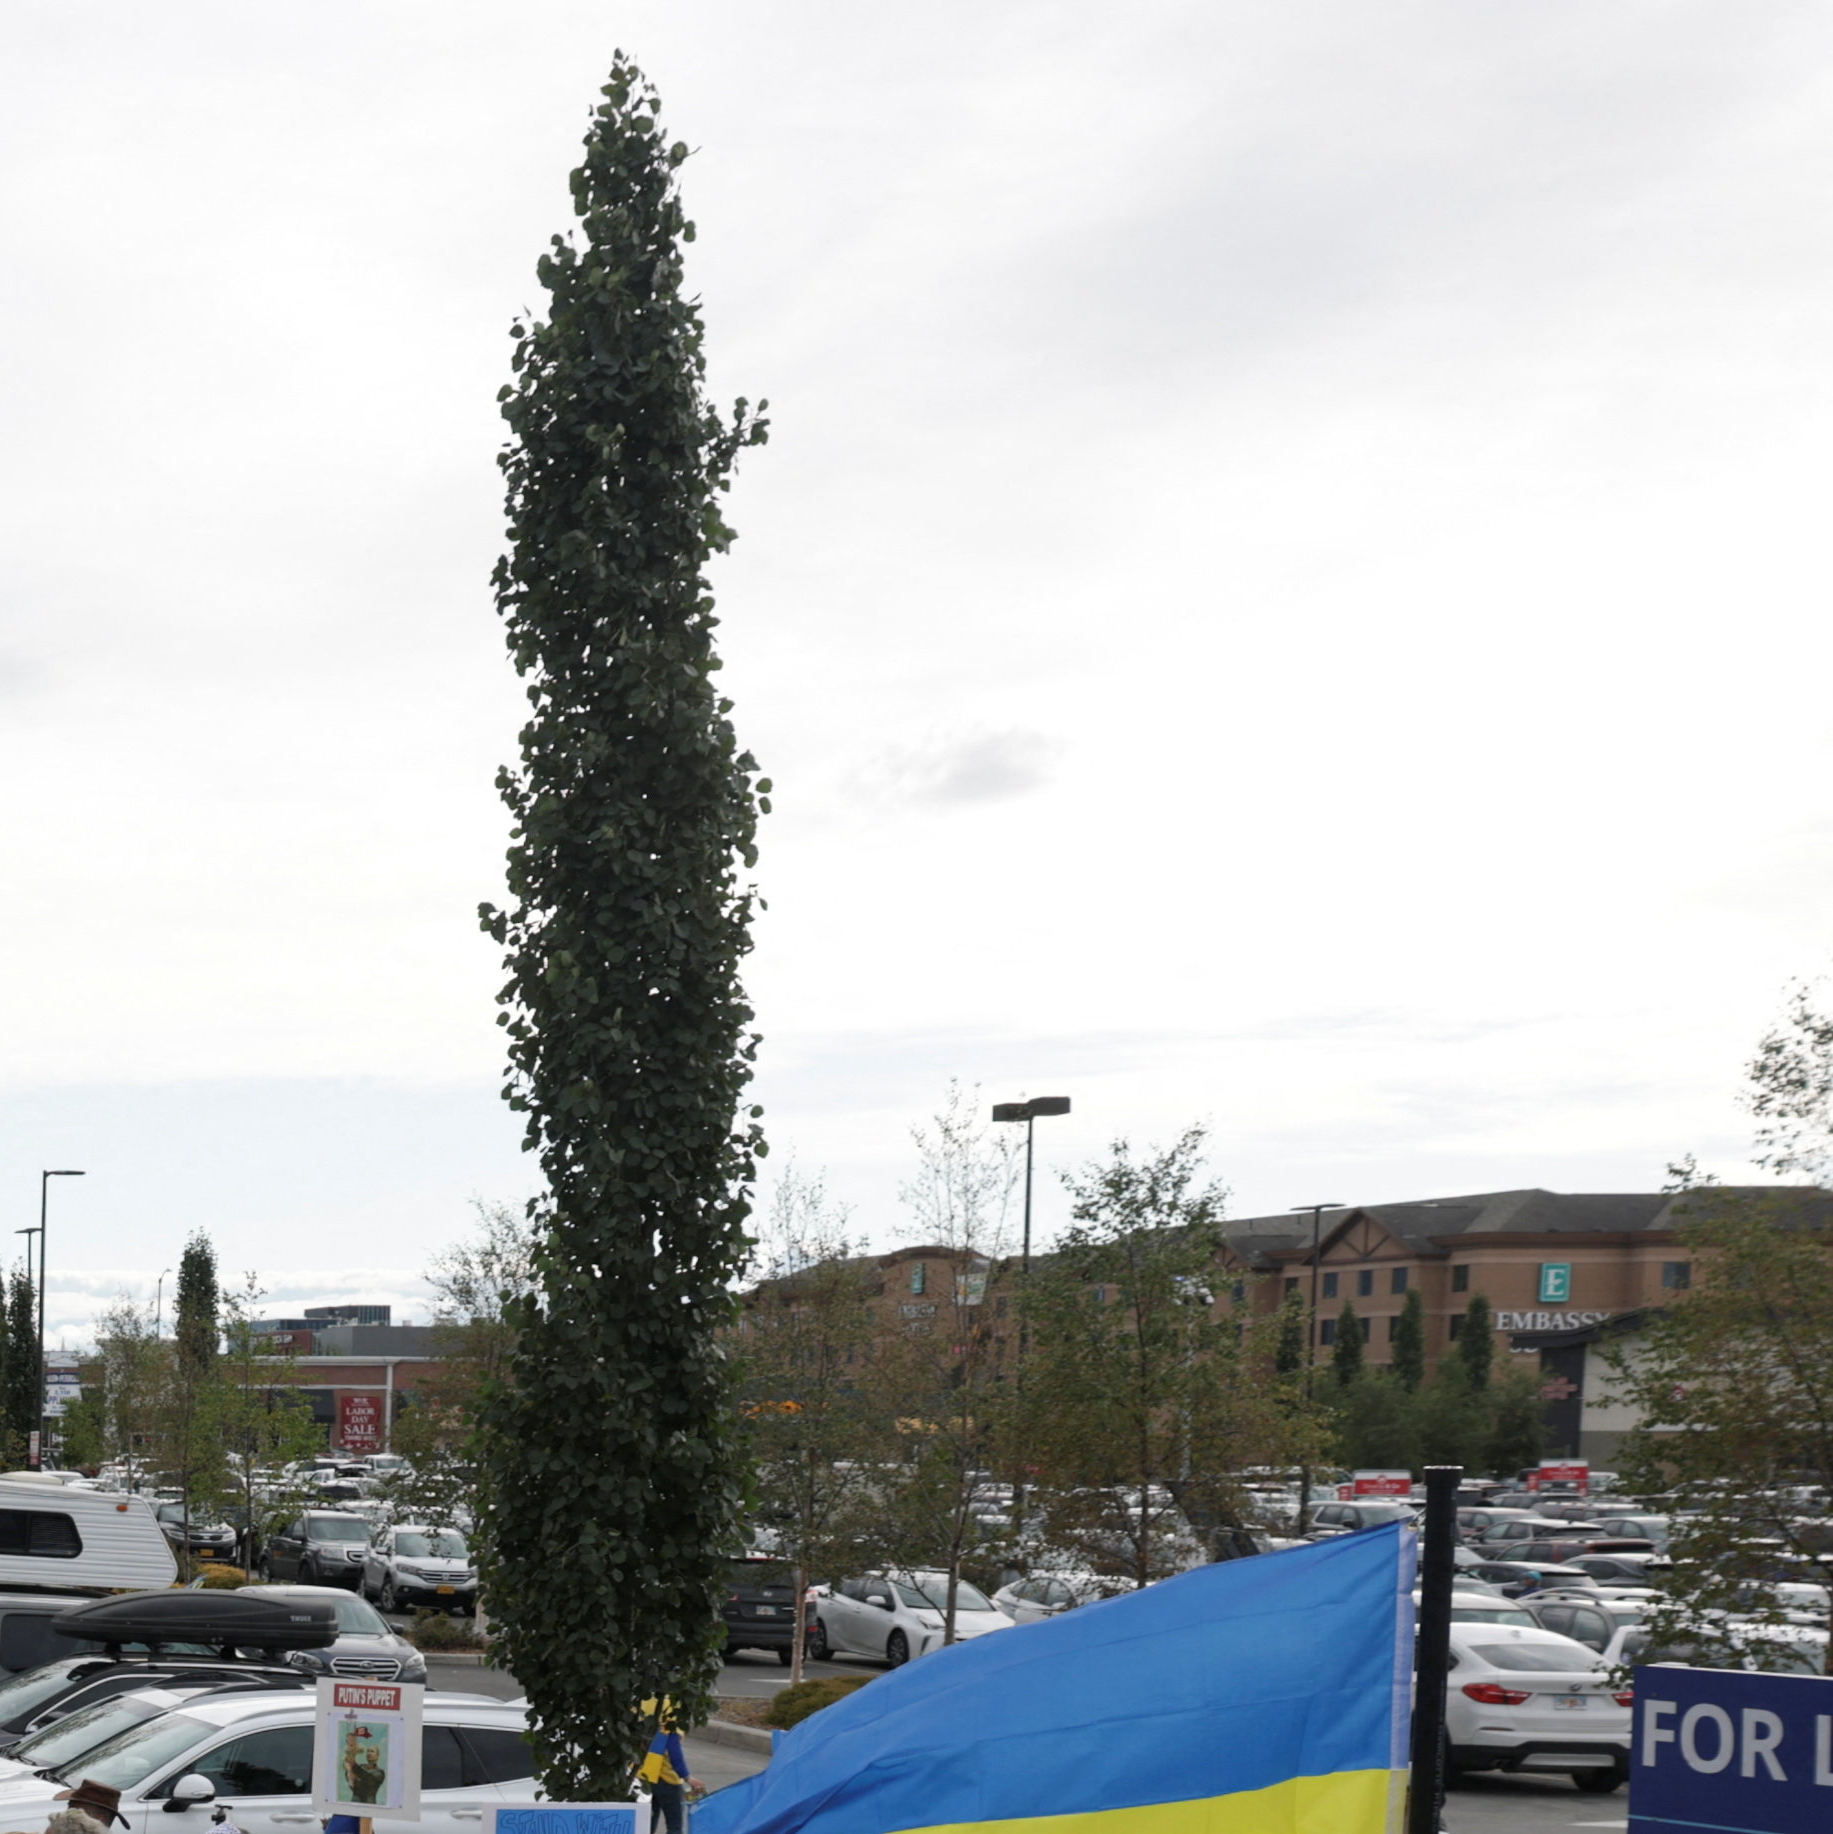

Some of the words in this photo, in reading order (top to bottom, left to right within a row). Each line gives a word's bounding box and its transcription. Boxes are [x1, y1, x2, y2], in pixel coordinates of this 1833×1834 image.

[346, 1407, 375, 1415] LABOR
[351, 1415, 370, 1424] DAY
[343, 1423, 376, 1435] SALE
[338, 1686, 367, 1706] PUTIN'S
[366, 1688, 396, 1707] PUPPET
[1642, 1699, 1789, 1782] FOR
